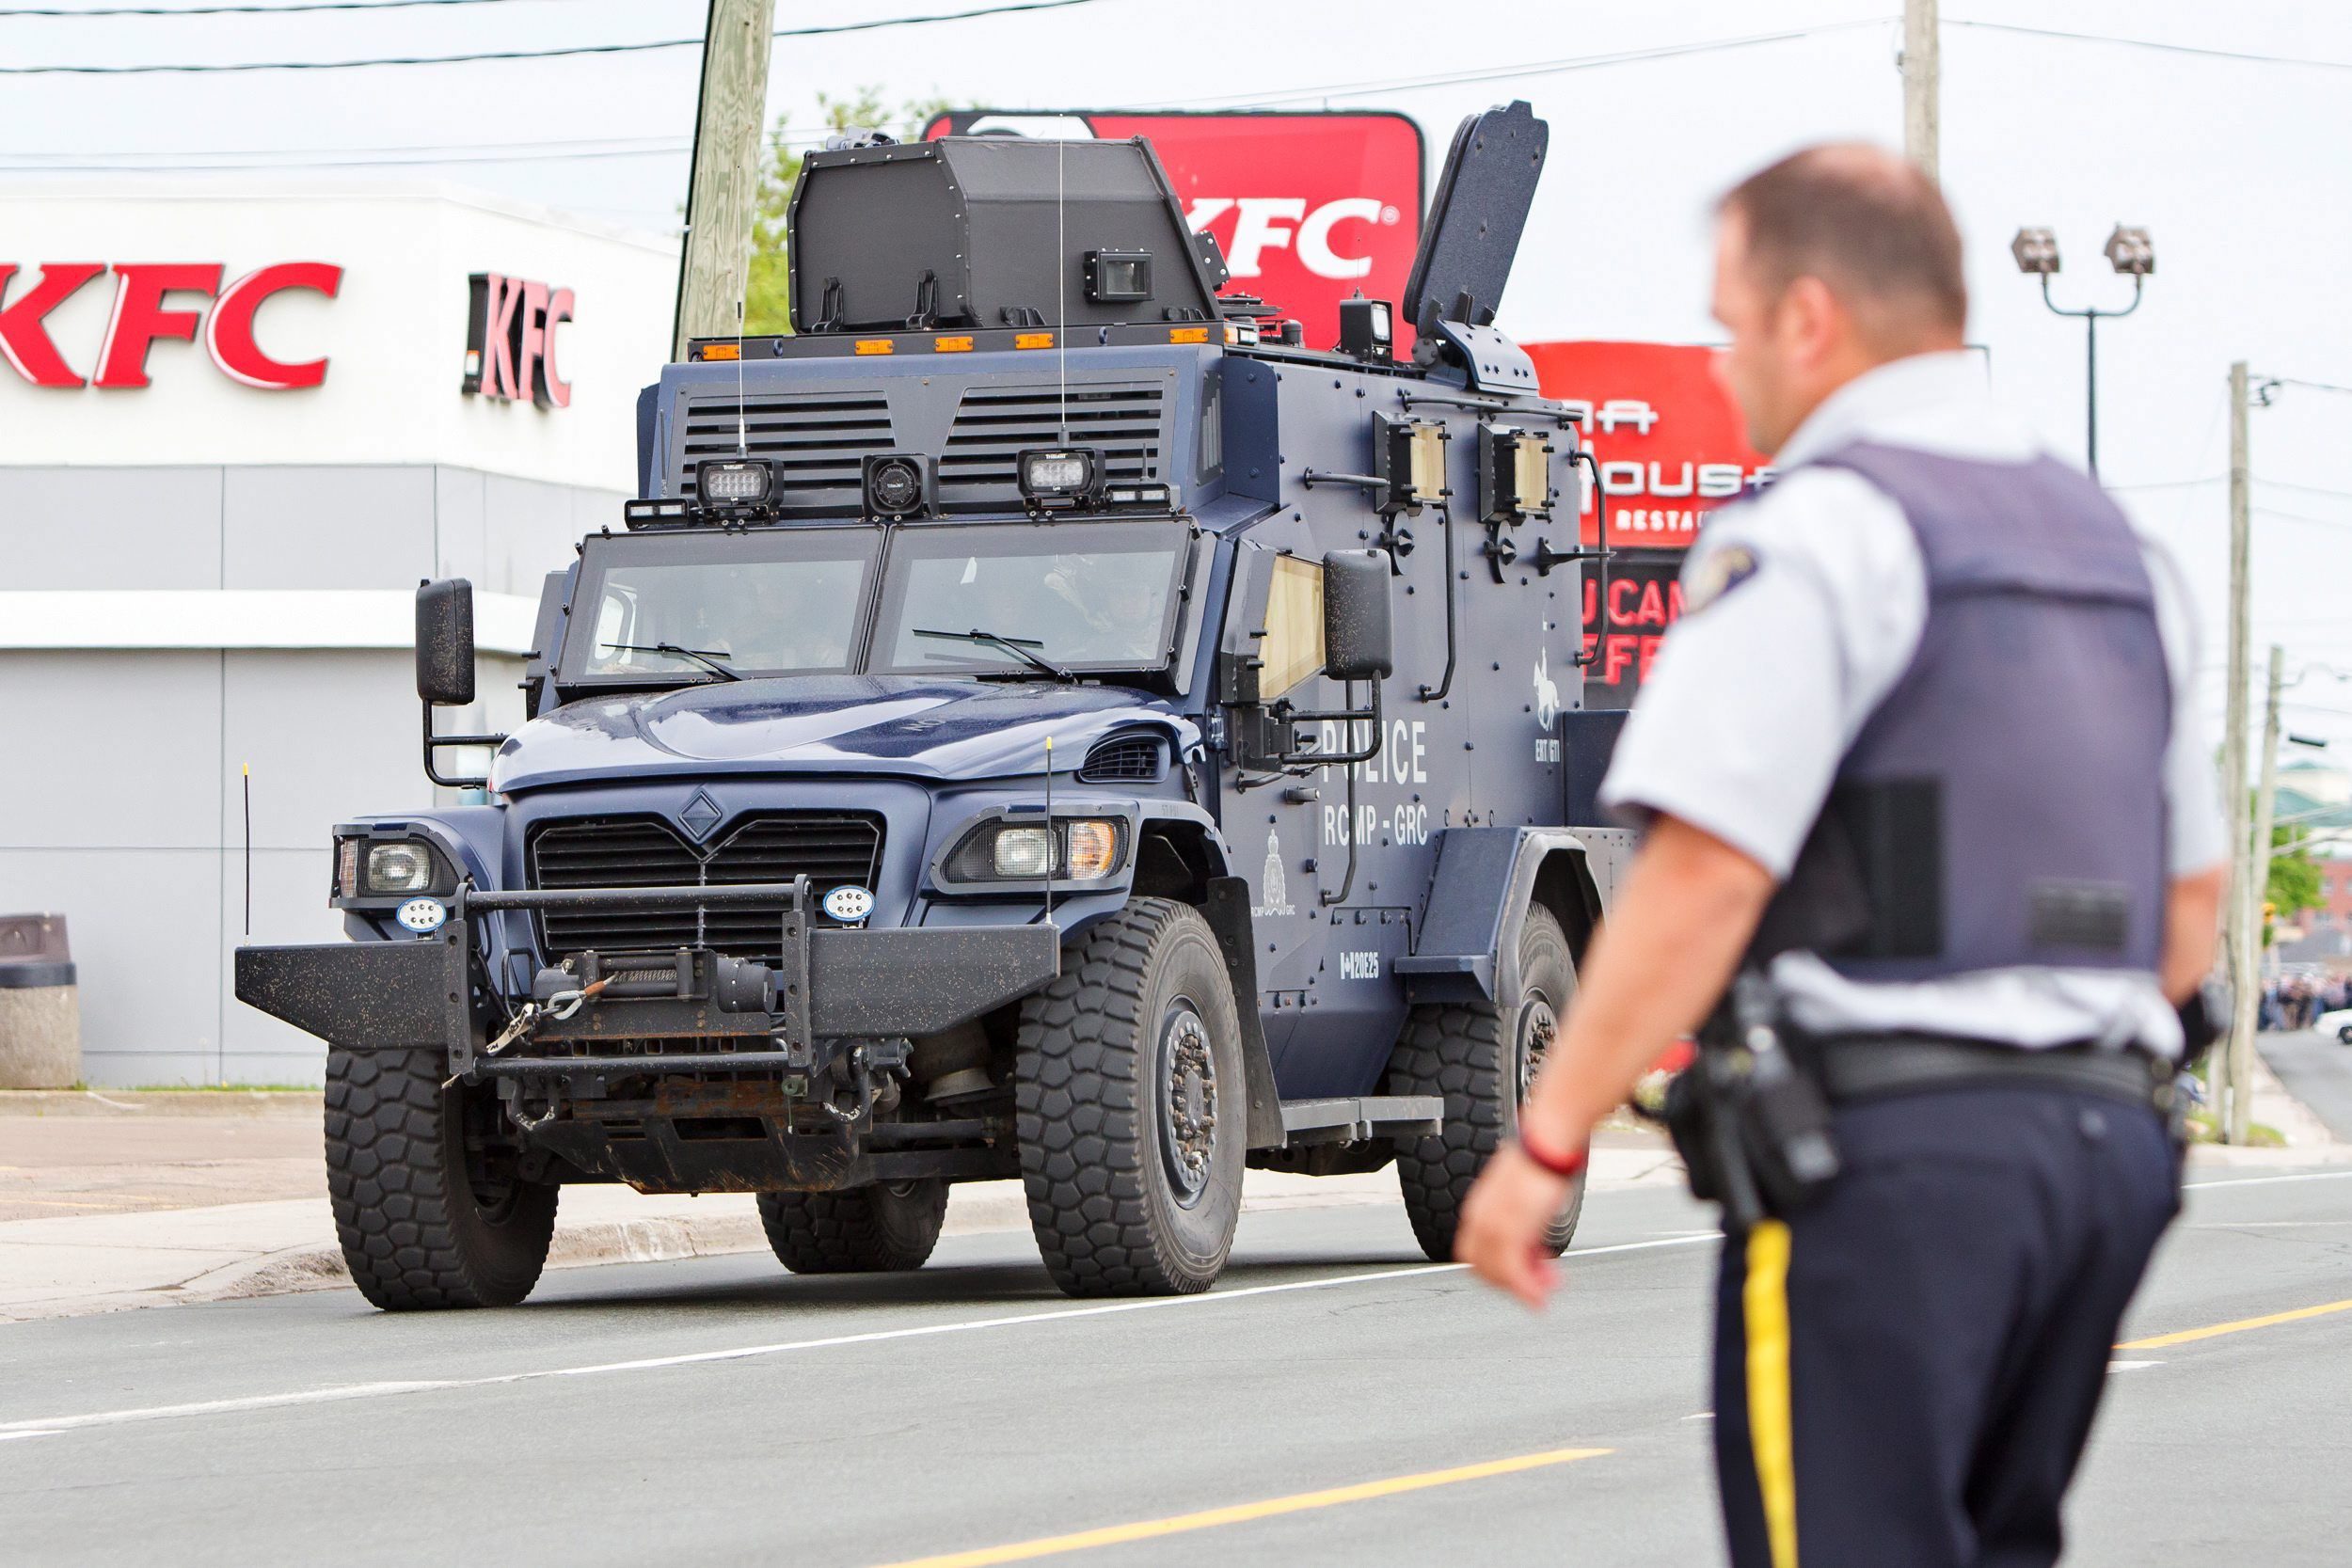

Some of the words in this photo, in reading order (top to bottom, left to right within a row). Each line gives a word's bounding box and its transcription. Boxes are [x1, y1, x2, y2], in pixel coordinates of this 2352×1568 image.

[0, 261, 344, 389] KFC
[480, 272, 575, 408] KFC
[1322, 719, 1427, 784] POLICE
[1394, 804, 1428, 846] GRC
[1355, 951, 1379, 979] 20E25
